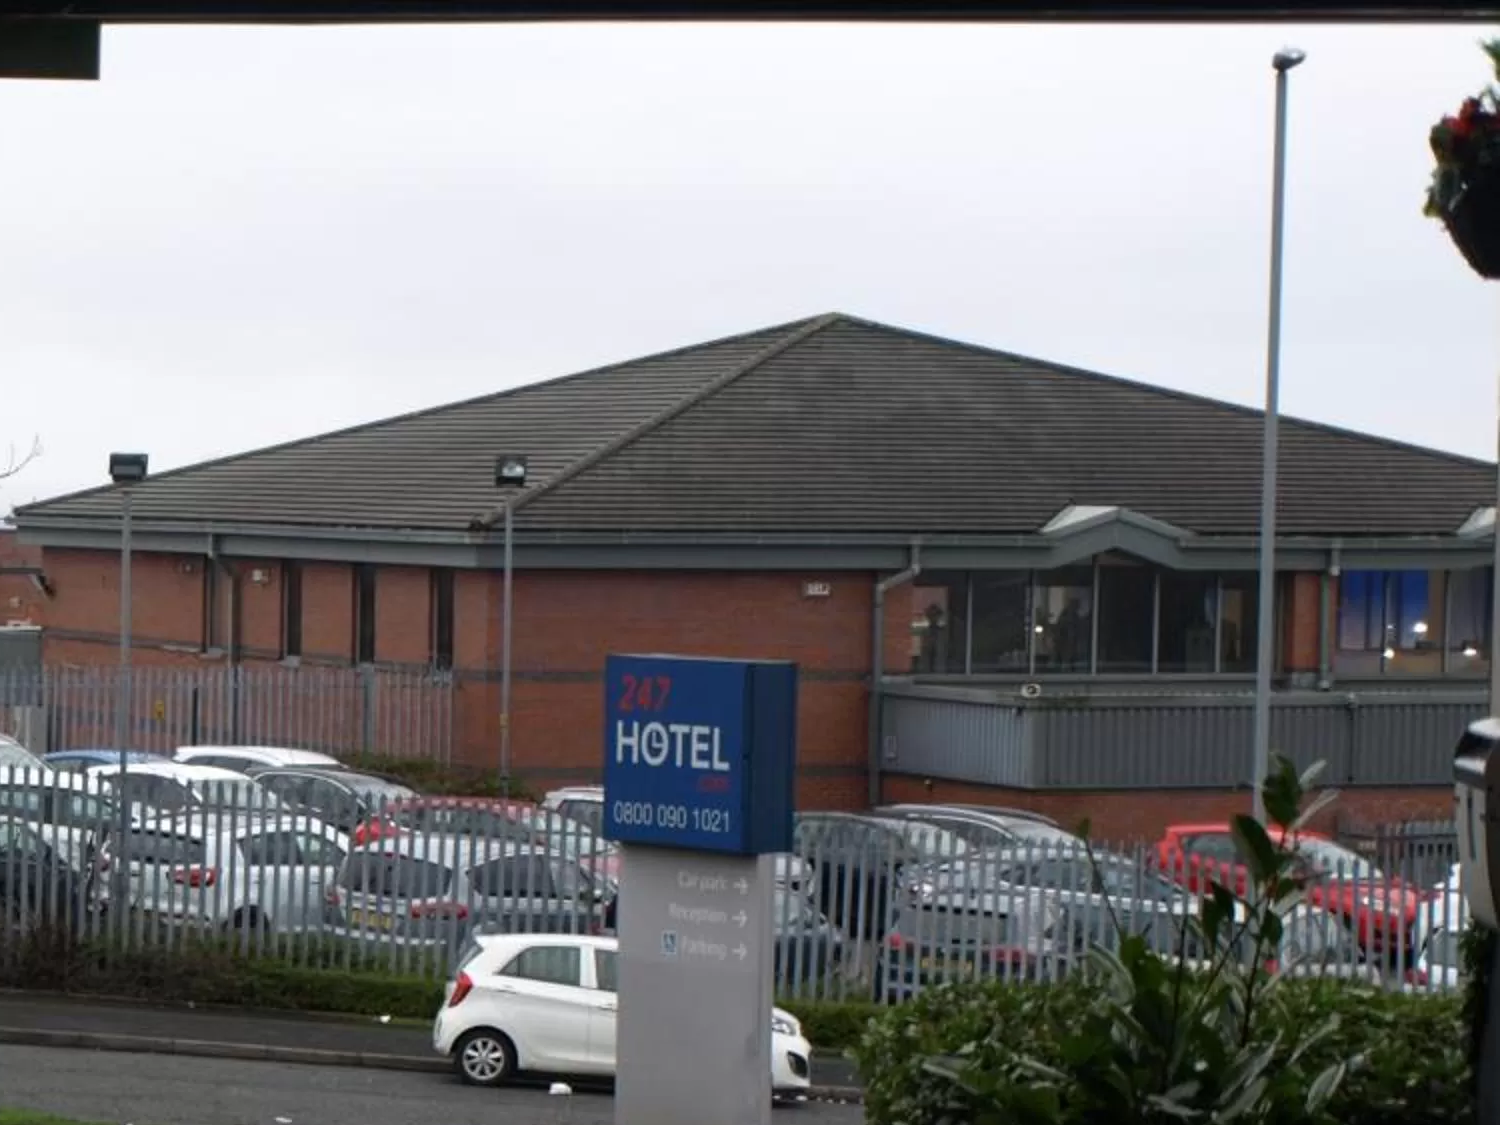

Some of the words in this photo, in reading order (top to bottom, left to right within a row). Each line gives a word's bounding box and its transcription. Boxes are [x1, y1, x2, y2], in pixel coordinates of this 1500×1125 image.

[618, 672, 672, 712] 247
[615, 719, 731, 771] HOTEL
[613, 801, 653, 825] 0800
[657, 804, 687, 829] 090
[692, 808, 730, 833] 1021
